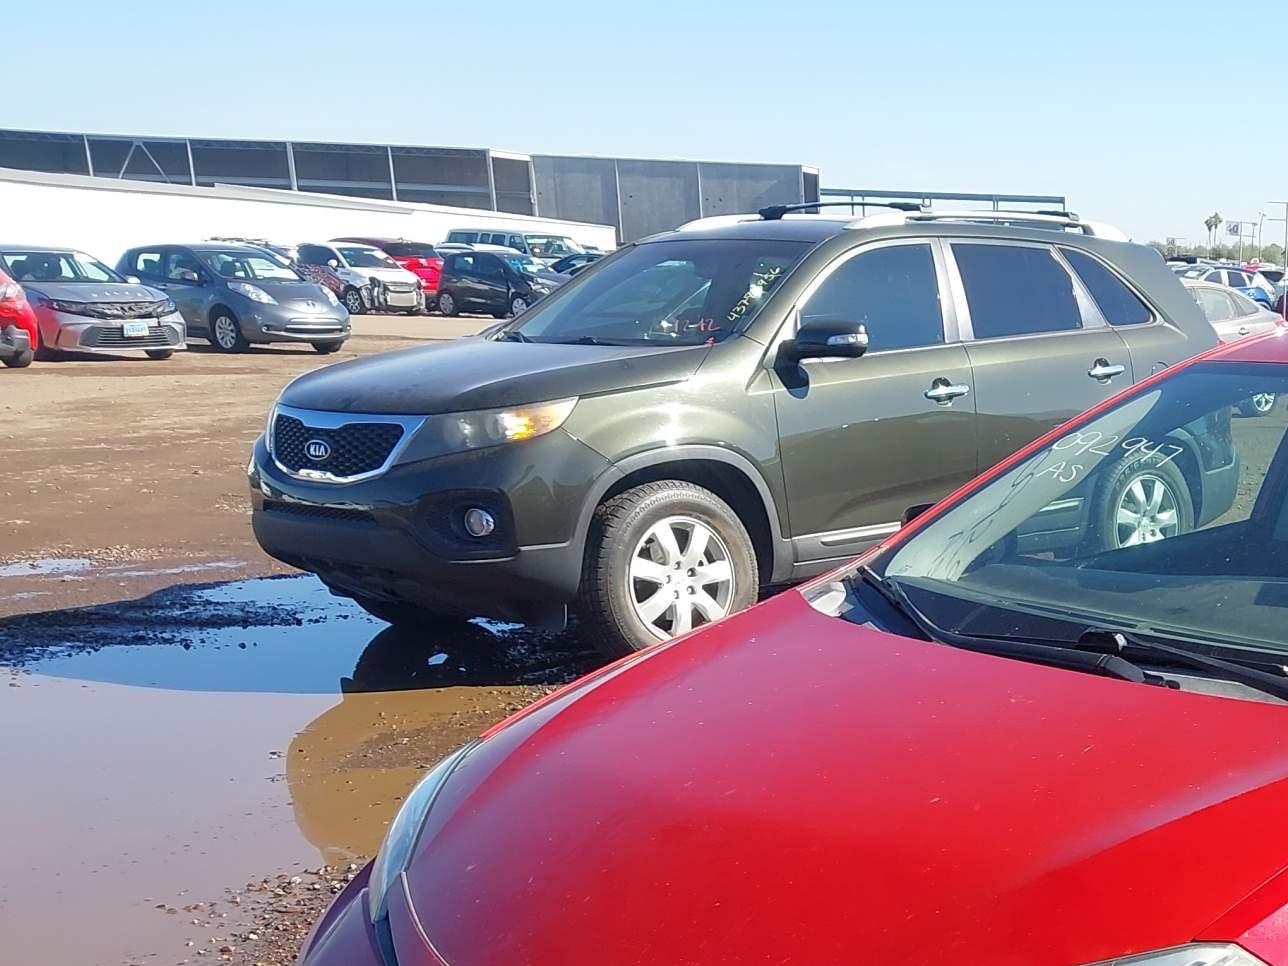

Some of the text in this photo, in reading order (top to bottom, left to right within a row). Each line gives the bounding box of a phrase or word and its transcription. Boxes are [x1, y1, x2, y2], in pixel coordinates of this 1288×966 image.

[309, 443, 326, 457] KIA
[1052, 431, 1184, 468] 092 947
